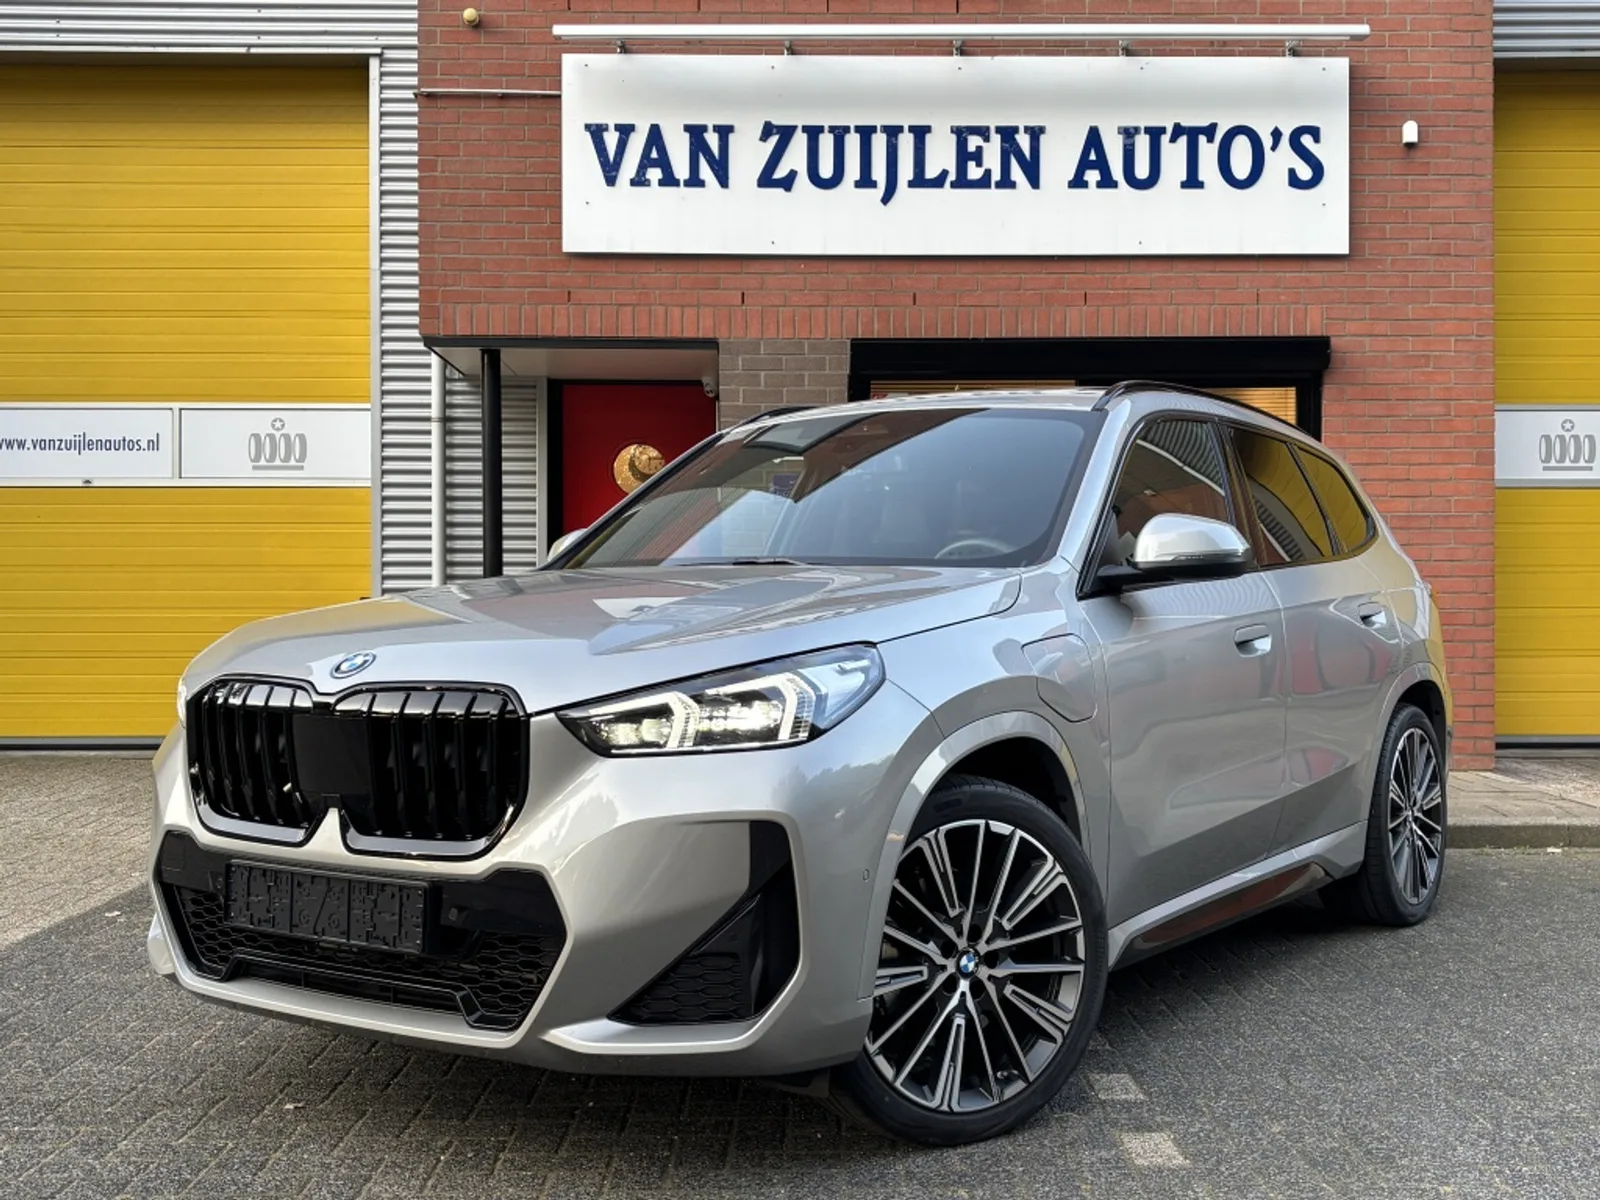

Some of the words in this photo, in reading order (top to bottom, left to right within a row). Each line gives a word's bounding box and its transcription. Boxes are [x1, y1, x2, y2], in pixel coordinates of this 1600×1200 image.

[584, 123, 734, 188] VAN
[757, 120, 1046, 206] ZUIJLEN
[1068, 122, 1324, 190] AUTO'S
